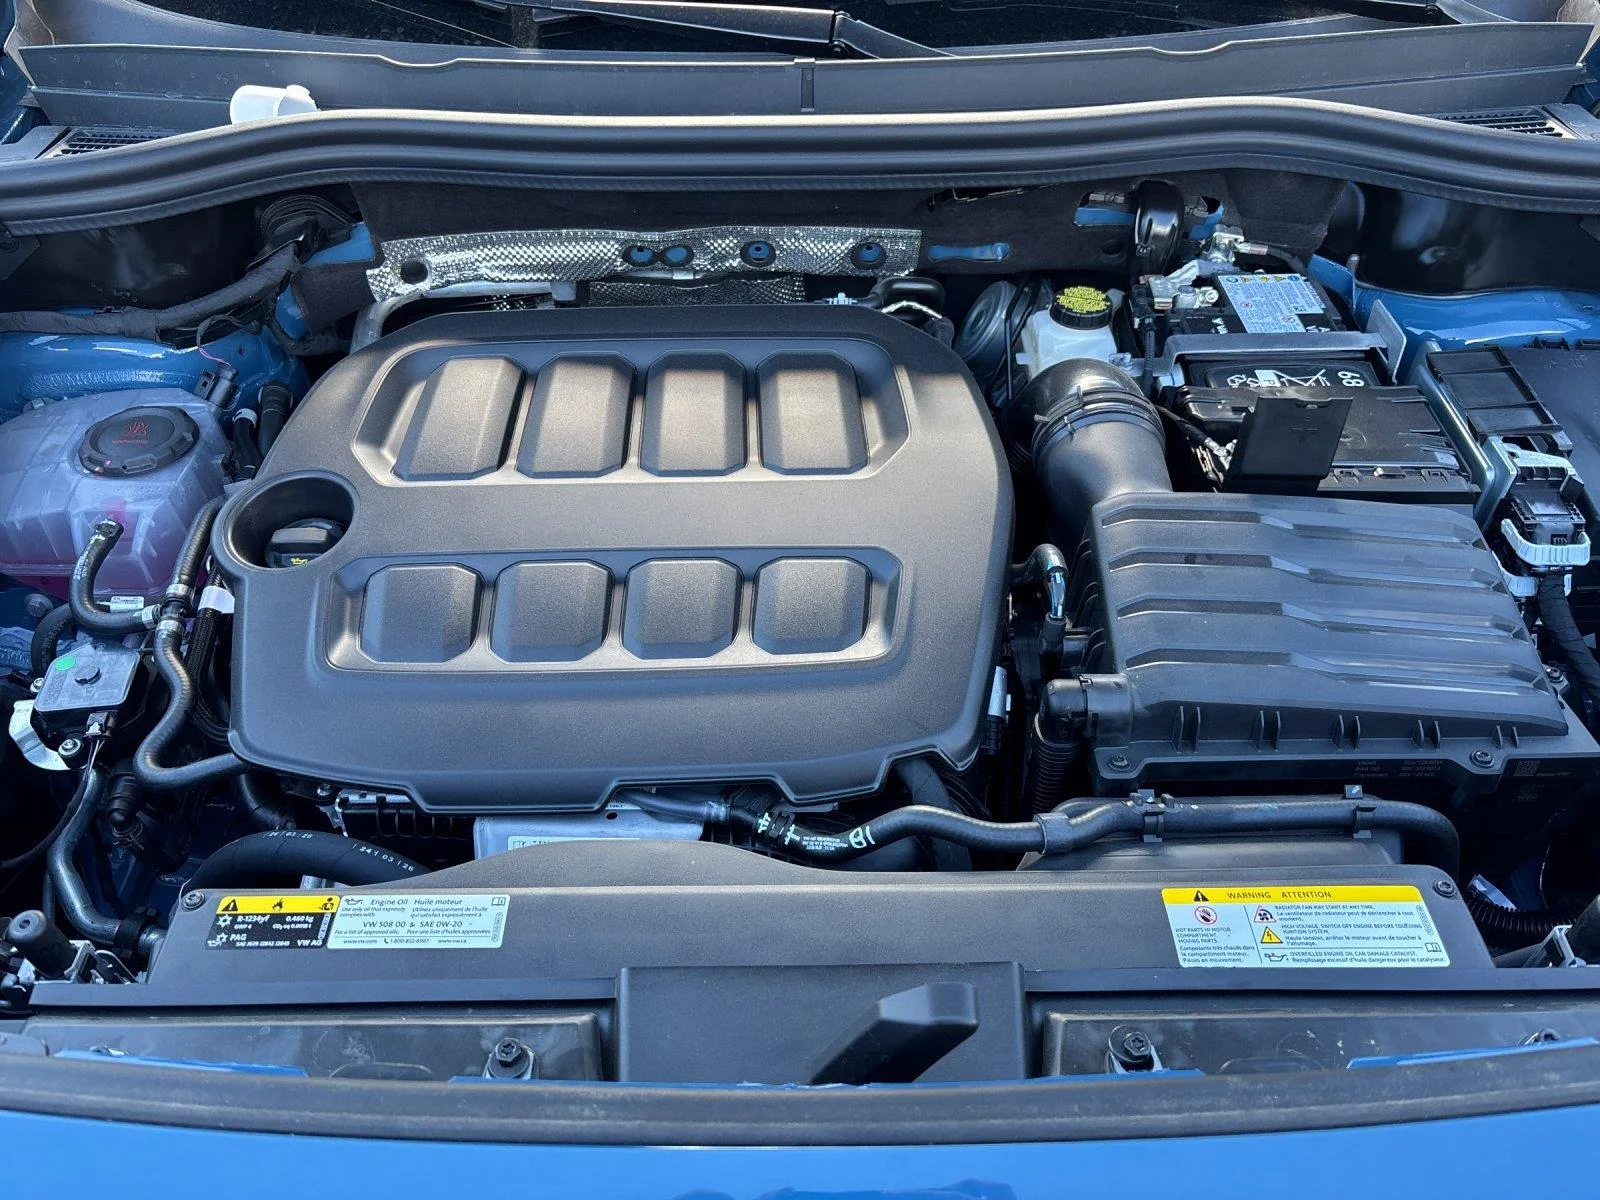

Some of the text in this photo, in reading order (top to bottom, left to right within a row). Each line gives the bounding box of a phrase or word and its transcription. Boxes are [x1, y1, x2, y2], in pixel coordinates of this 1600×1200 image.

[382, 854, 394, 862] 03
[1281, 891, 1332, 899] ATTENTION
[371, 899, 396, 907] Engine
[236, 915, 271, 924] R-1234yf
[230, 933, 247, 941] PAG
[297, 939, 311, 947] VW
